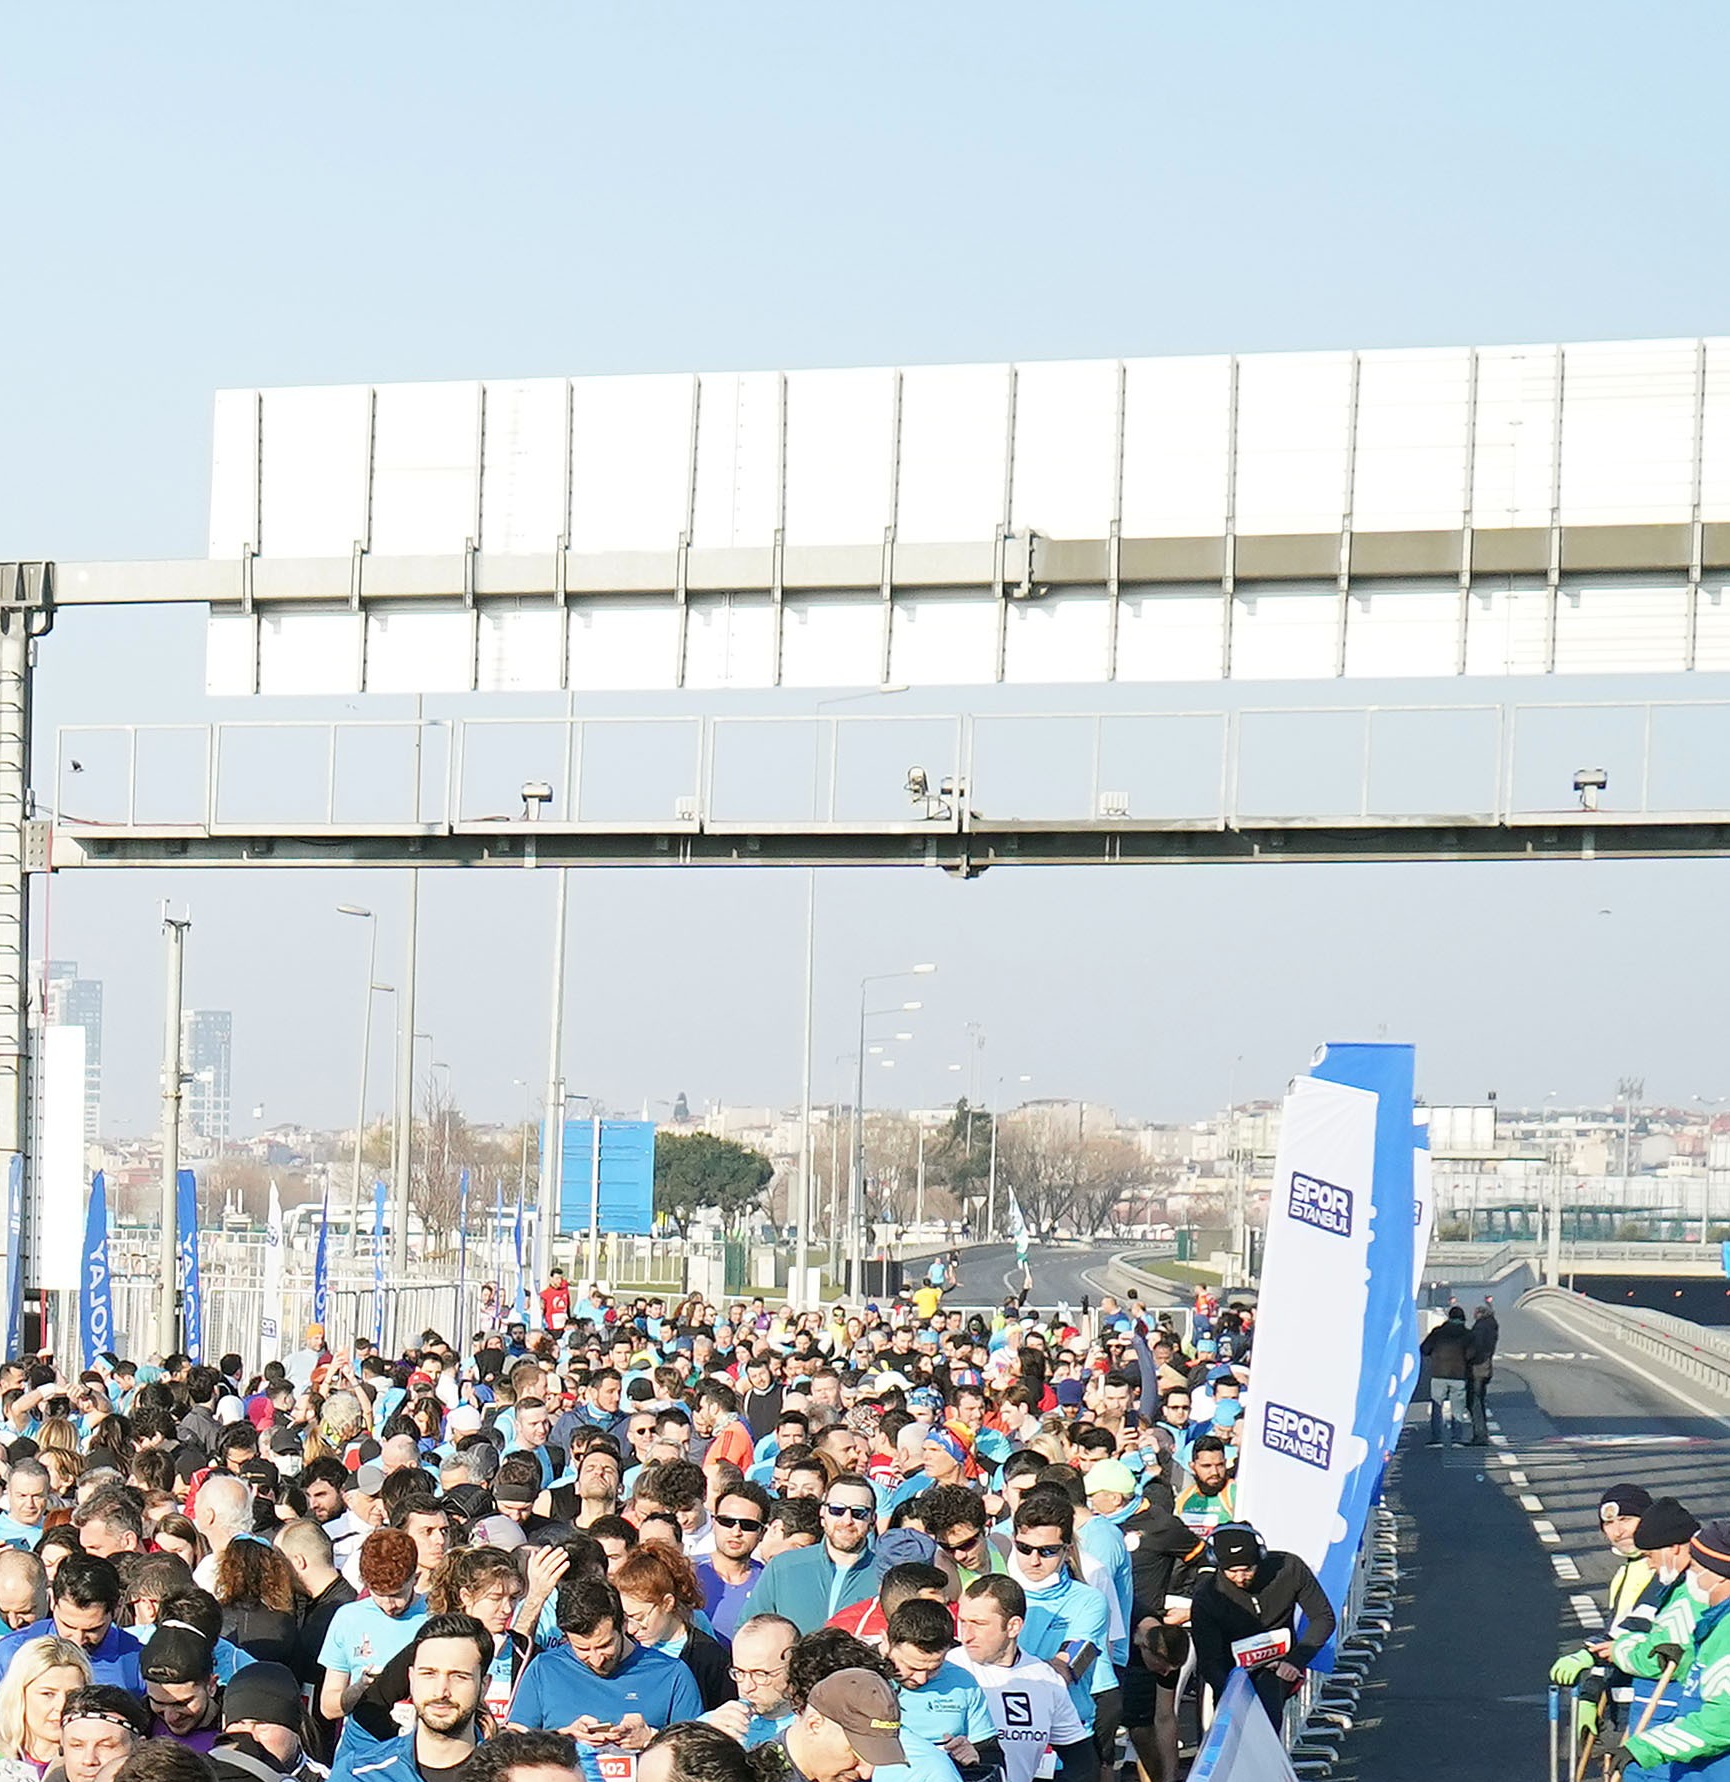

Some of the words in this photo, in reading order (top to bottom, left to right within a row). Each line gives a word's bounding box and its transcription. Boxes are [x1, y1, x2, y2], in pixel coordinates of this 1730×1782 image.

[1293, 1176, 1349, 1217] SPOR
[90, 1241, 109, 1358] KOLAY
[1267, 1406, 1330, 1450] SPOR
